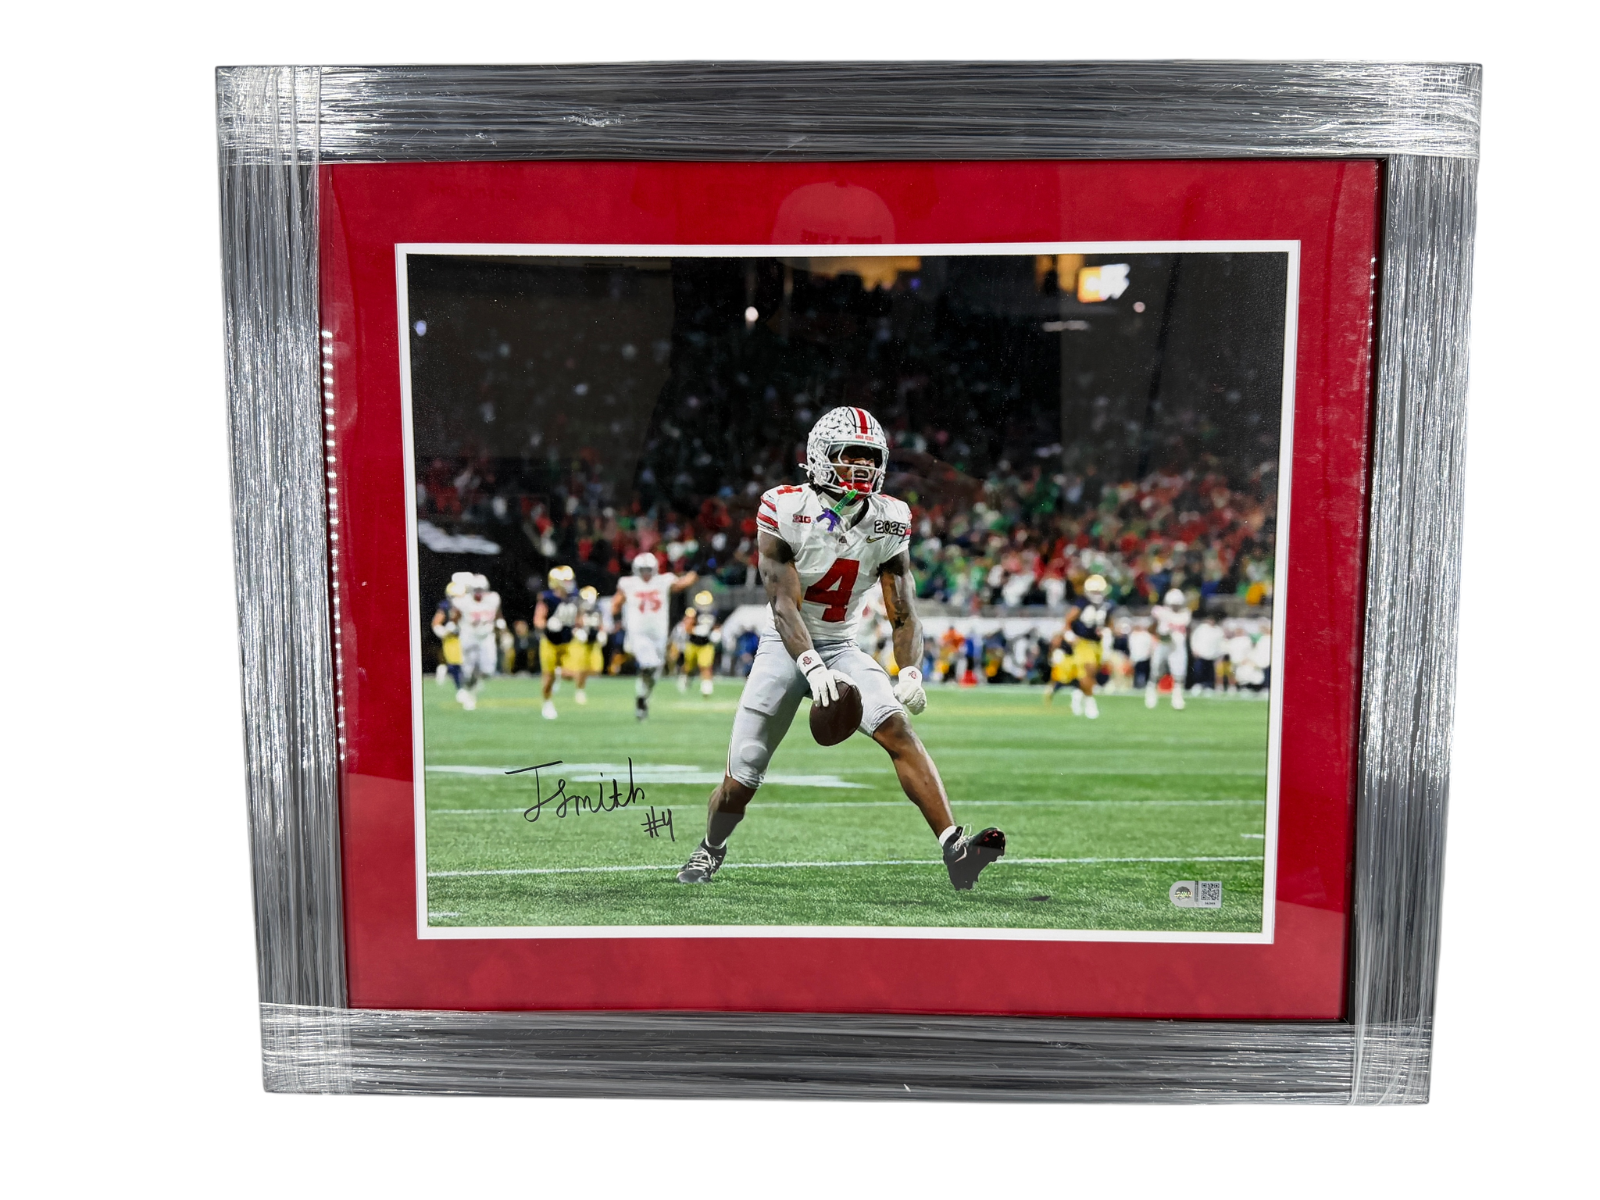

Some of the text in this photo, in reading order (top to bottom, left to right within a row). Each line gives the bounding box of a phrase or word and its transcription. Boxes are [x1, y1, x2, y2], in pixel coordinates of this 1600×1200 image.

[874, 519, 907, 537] 2025
[634, 590, 662, 614] 75
[804, 557, 860, 623] 4
[640, 805, 676, 842] #4
